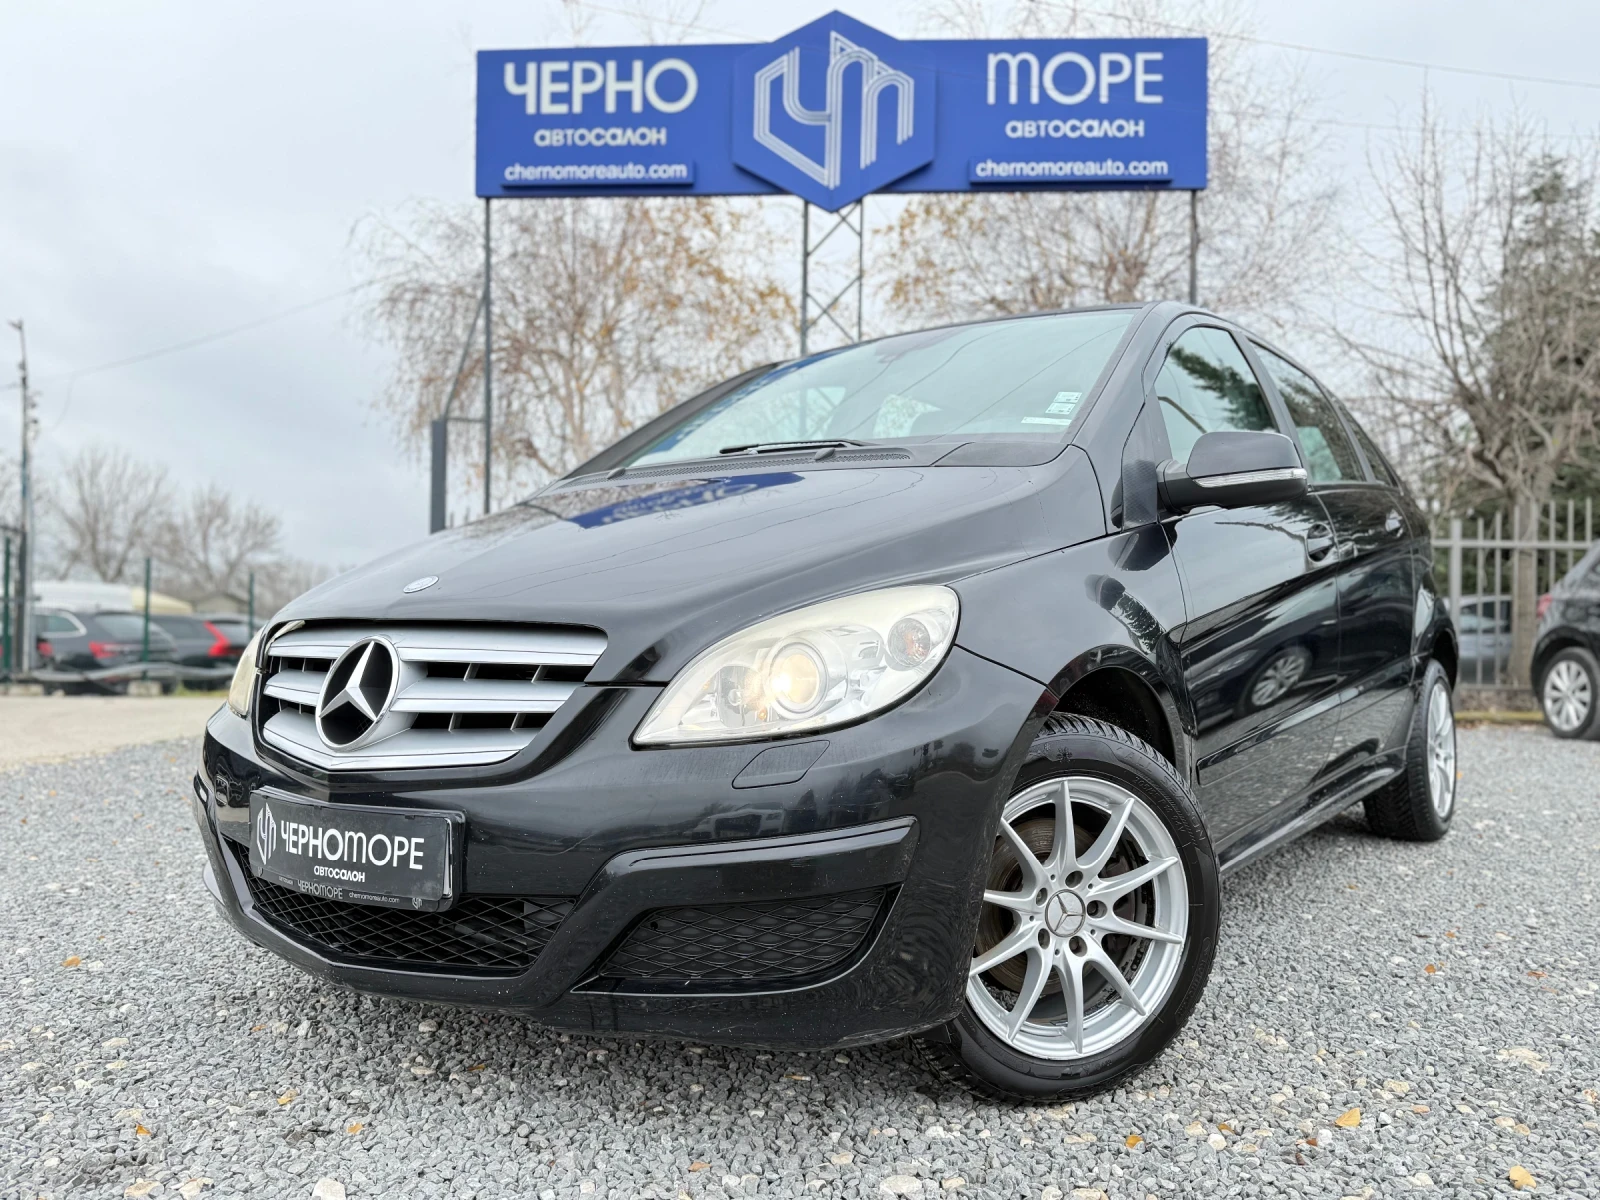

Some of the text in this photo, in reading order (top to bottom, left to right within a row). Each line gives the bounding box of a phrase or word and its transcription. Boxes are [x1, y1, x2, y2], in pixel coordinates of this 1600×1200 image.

[504, 58, 698, 115] ЧЕРНО
[534, 126, 667, 147] автосалон
[1005, 118, 1145, 138] автосалон
[504, 162, 687, 181] chernomoreauto.com
[975, 158, 1168, 177] chernomoreauto.com
[314, 865, 365, 883] автосалон
